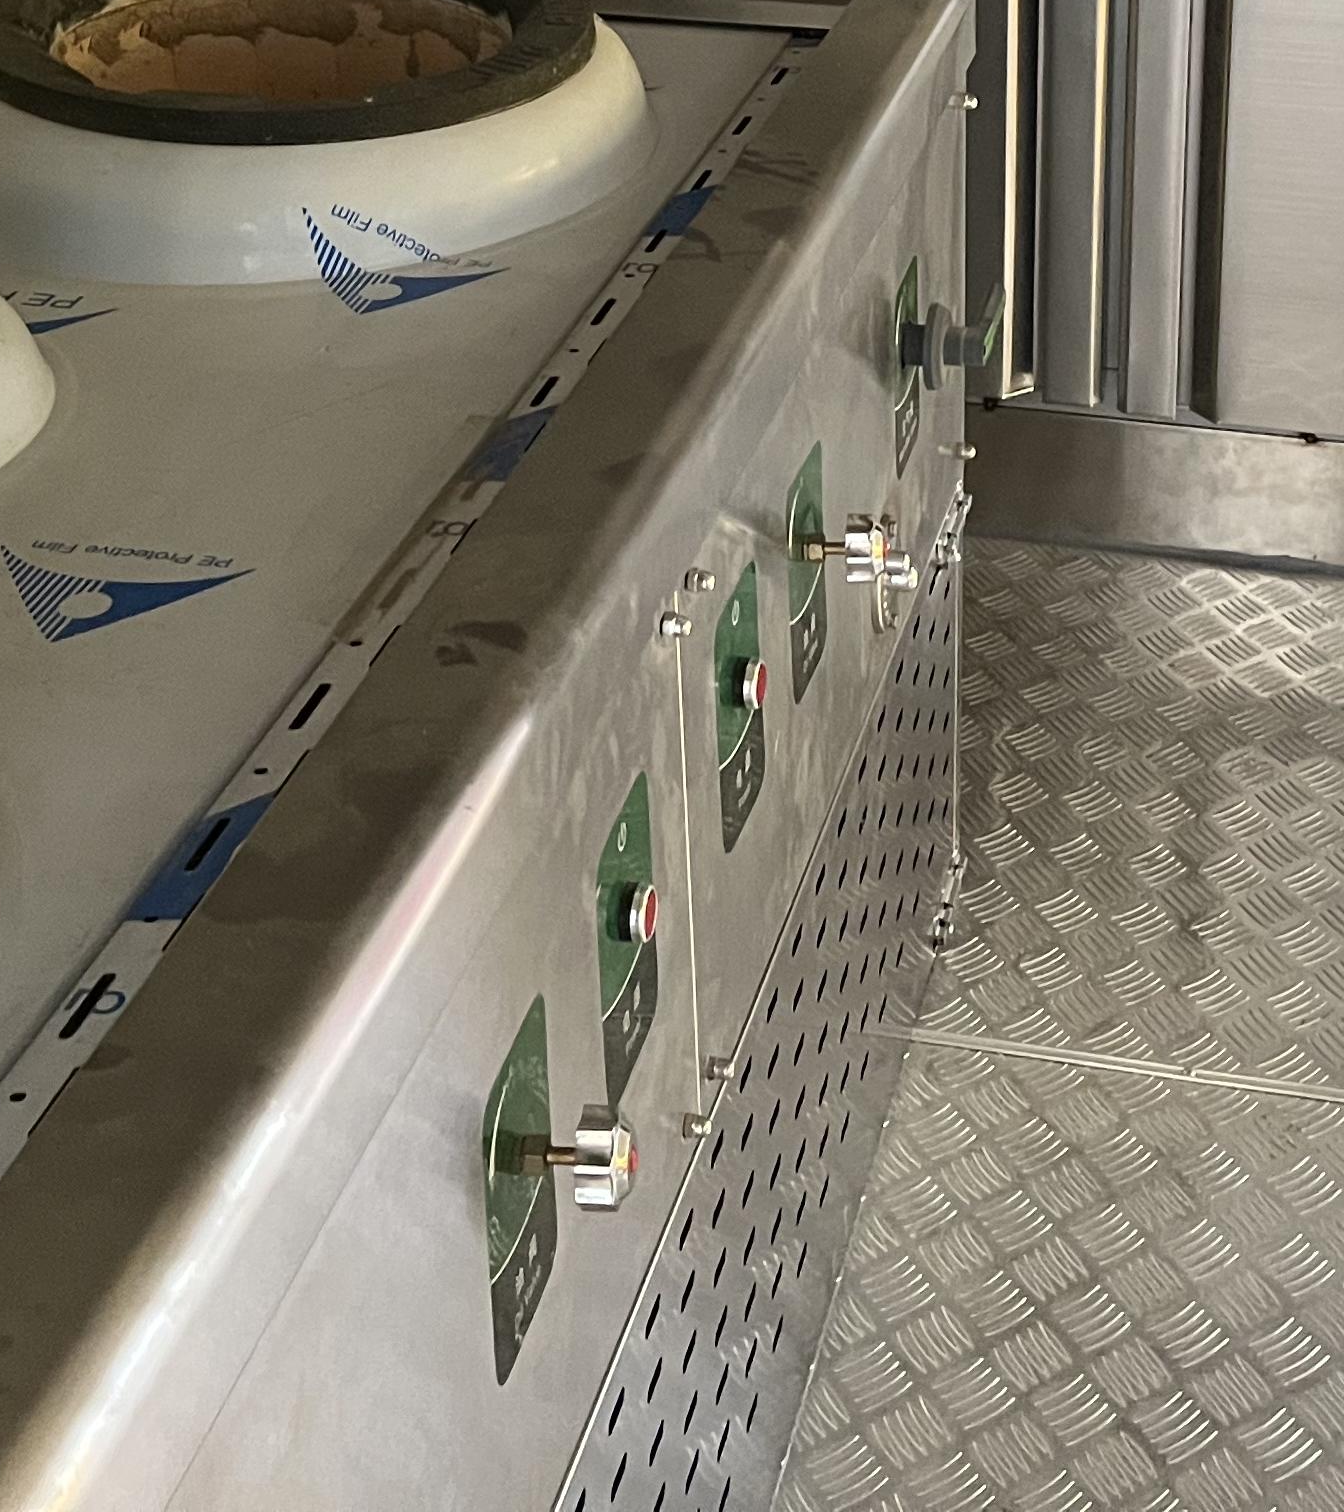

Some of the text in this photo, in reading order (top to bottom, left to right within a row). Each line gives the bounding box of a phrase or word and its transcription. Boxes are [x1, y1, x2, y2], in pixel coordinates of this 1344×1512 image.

[330, 203, 462, 266] otective Film
[20, 291, 84, 309] PE
[31, 539, 235, 569] PE Protective Film
